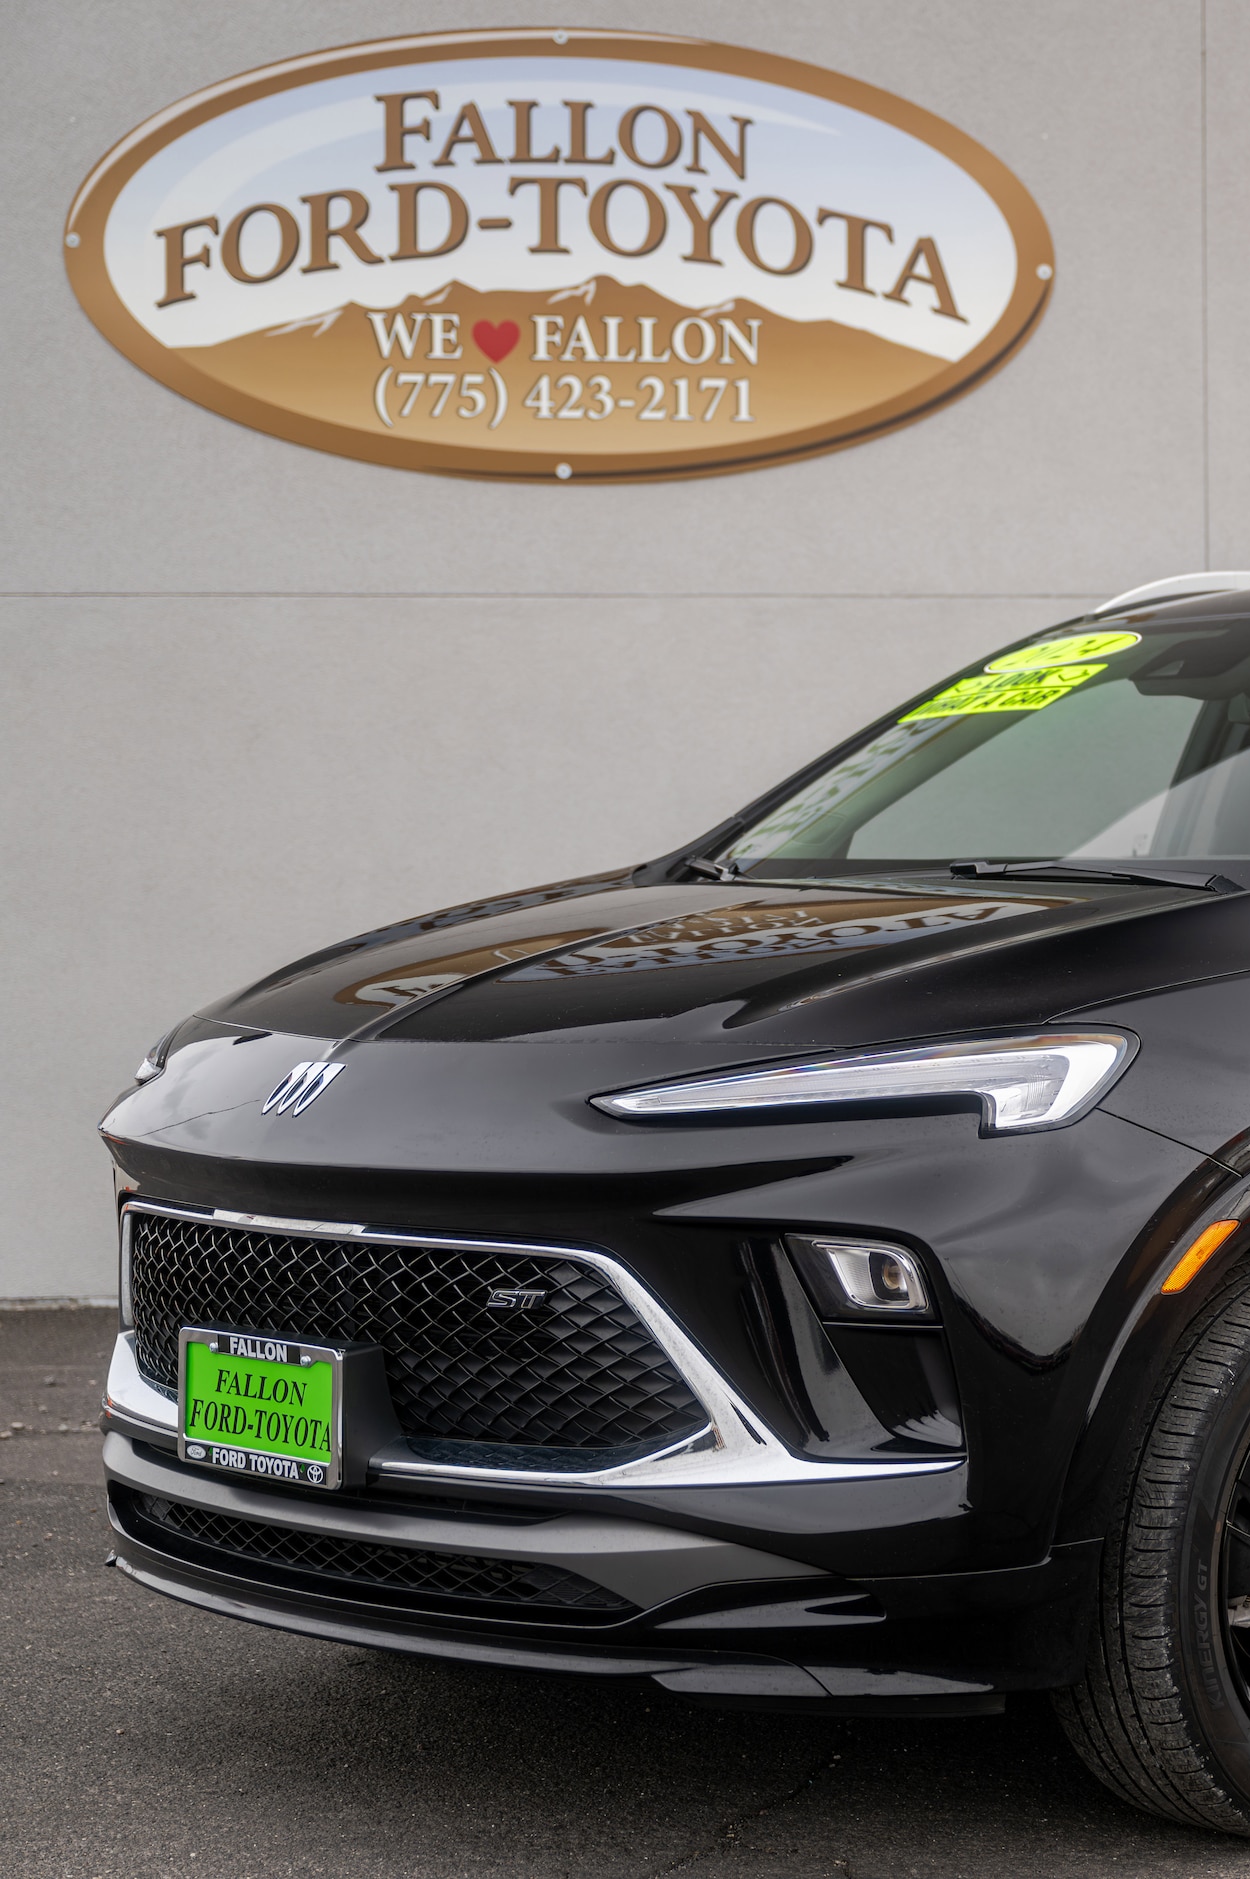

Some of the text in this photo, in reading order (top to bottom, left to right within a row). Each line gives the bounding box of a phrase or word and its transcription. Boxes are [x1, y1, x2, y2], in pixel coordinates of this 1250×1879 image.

[374, 90, 753, 180] FALLON
[154, 176, 969, 324] FORD-TOYOTA
[367, 312, 762, 364] WE FALLON
[374, 366, 755, 429] (775) 423-2171
[487, 1290, 546, 1309] ST
[229, 1337, 288, 1363] FALLON
[215, 1368, 308, 1408] FALLON
[189, 1398, 332, 1452] FORD-TOYOTA
[211, 1447, 300, 1479] FORD TOYOTA
[1194, 1559, 1226, 1713] KINERGY GT
